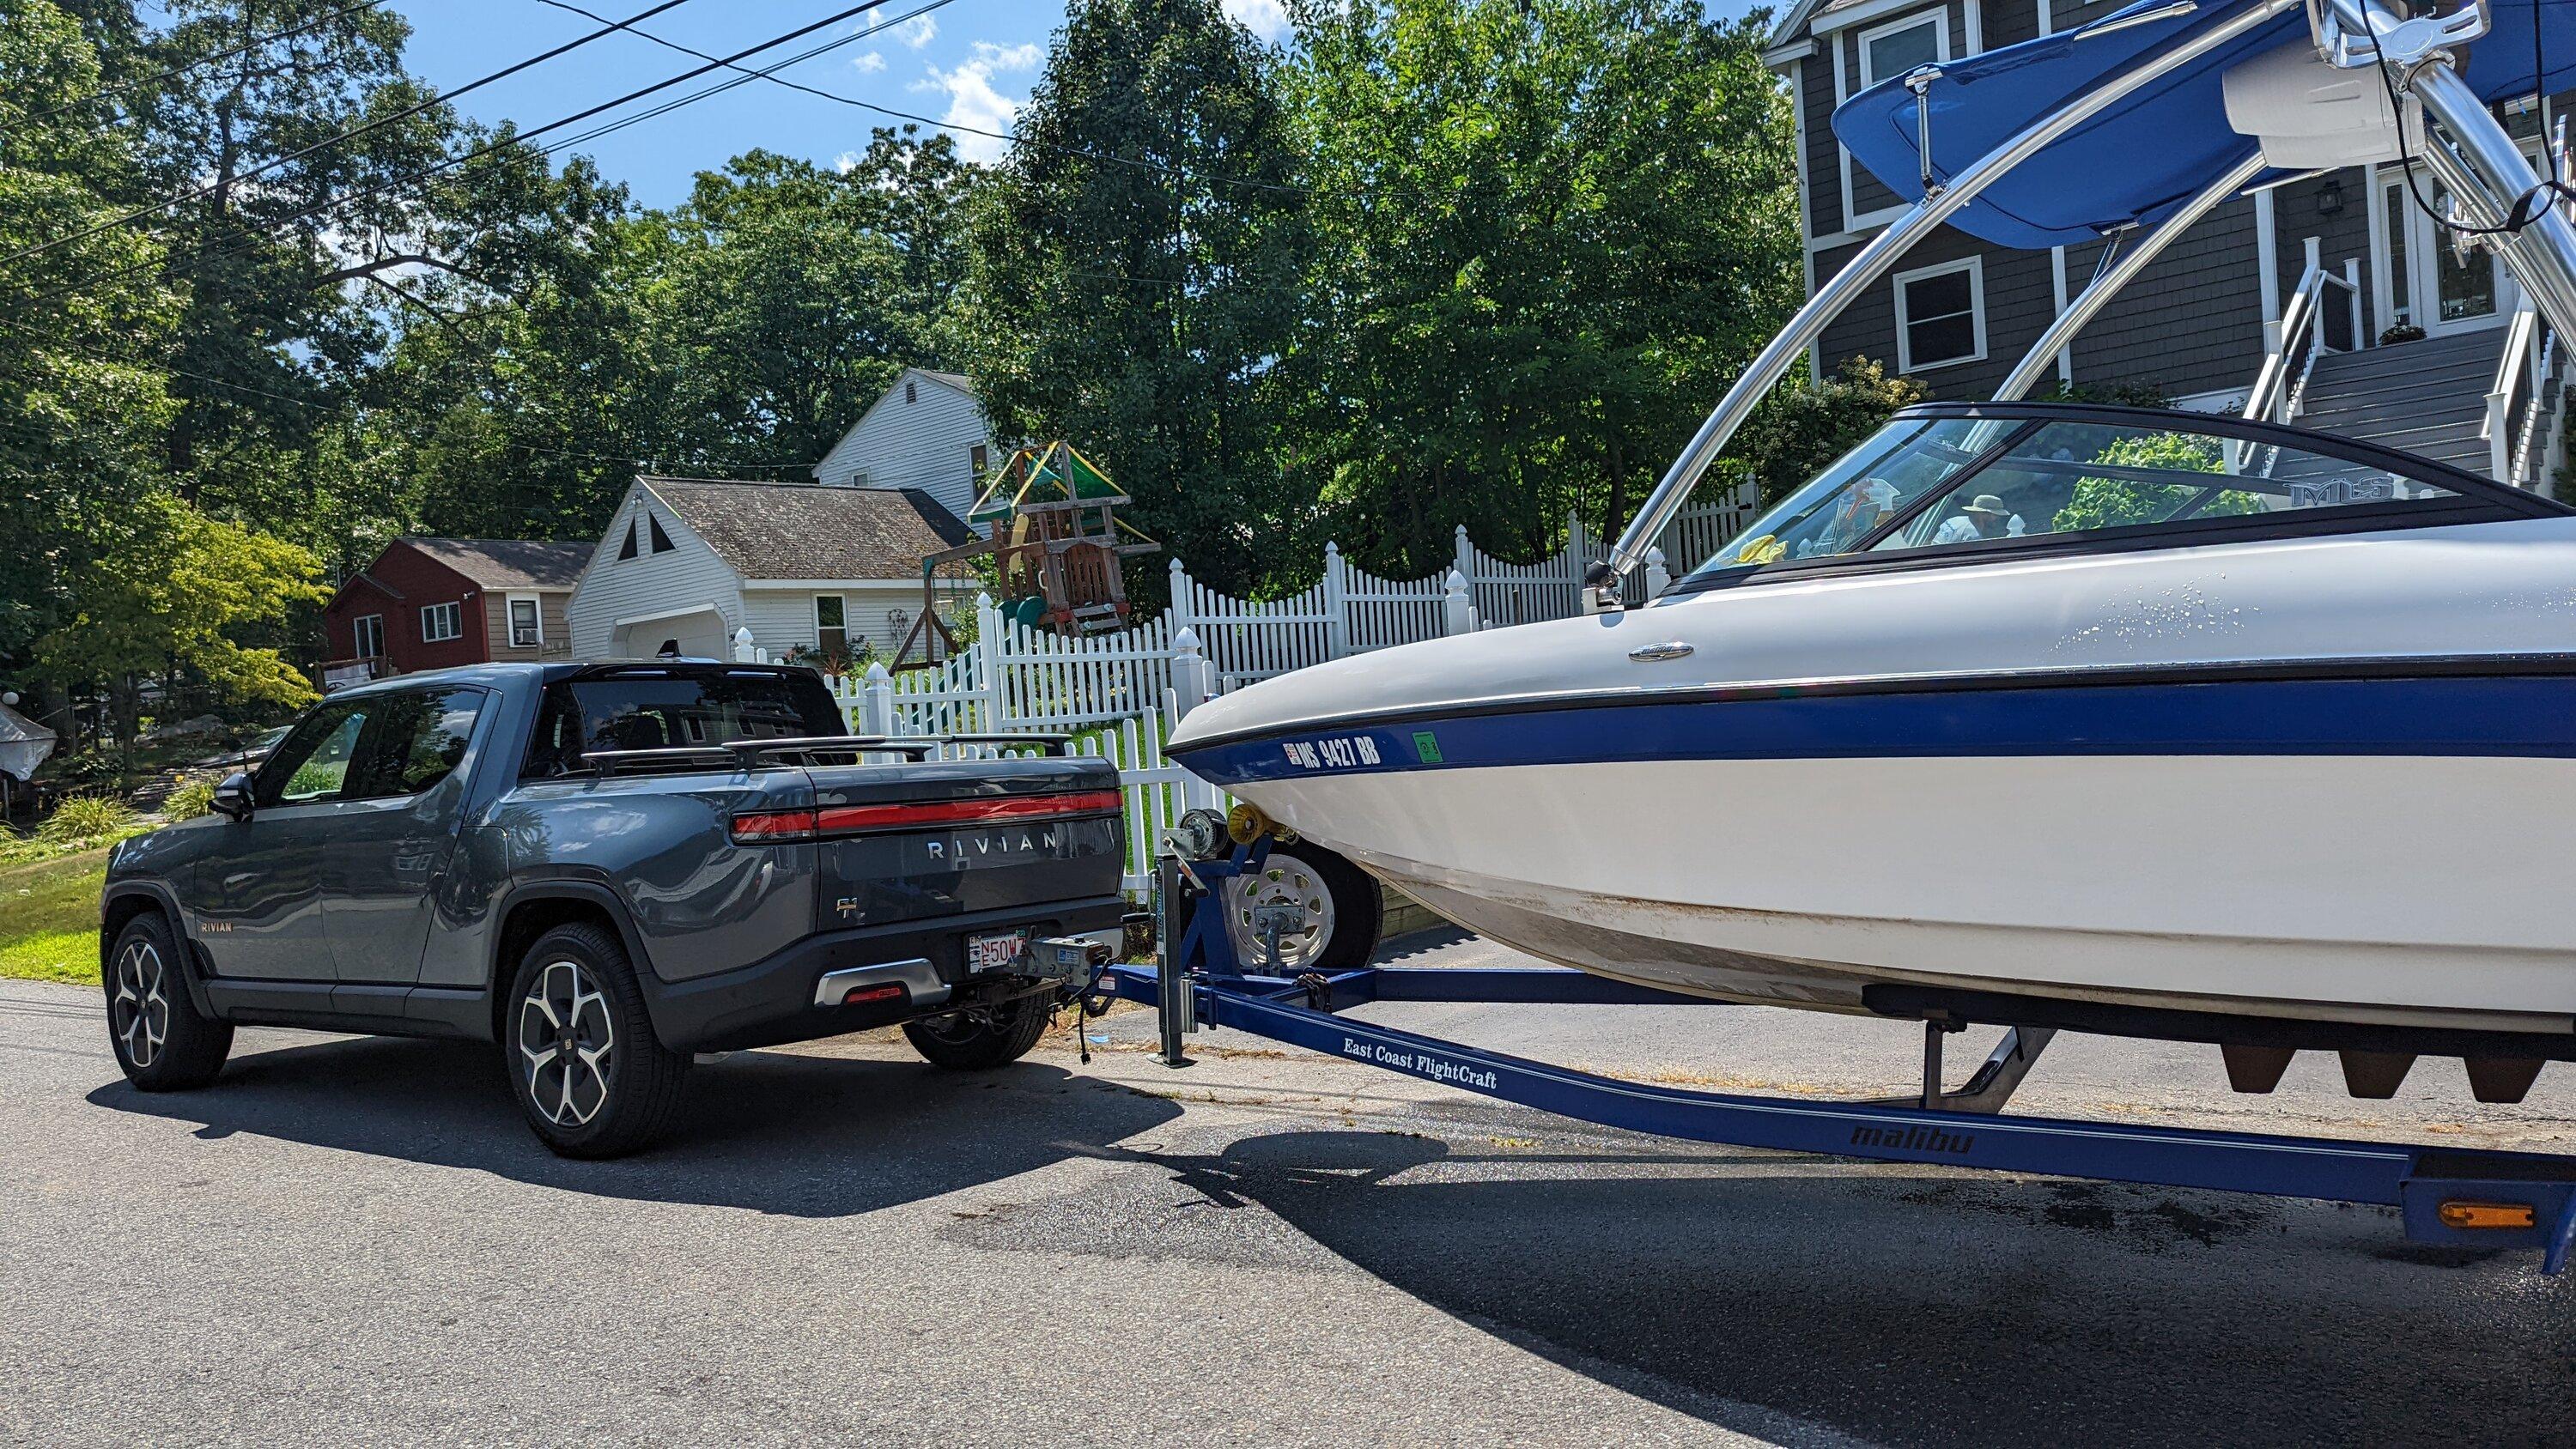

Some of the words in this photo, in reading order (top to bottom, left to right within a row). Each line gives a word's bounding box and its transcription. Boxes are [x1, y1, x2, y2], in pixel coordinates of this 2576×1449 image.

[1295, 742, 1321, 768] MS
[1318, 737, 1357, 767] 9427
[1354, 736, 1381, 765] BB
[927, 831, 1057, 859] RIVIAN
[201, 922, 233, 933] RIVIAN
[1343, 1037, 1373, 1058] East
[1376, 1045, 1413, 1069] Coast
[1416, 1054, 1497, 1089] FlightCraft
[1850, 1125, 1974, 1154] malibu
